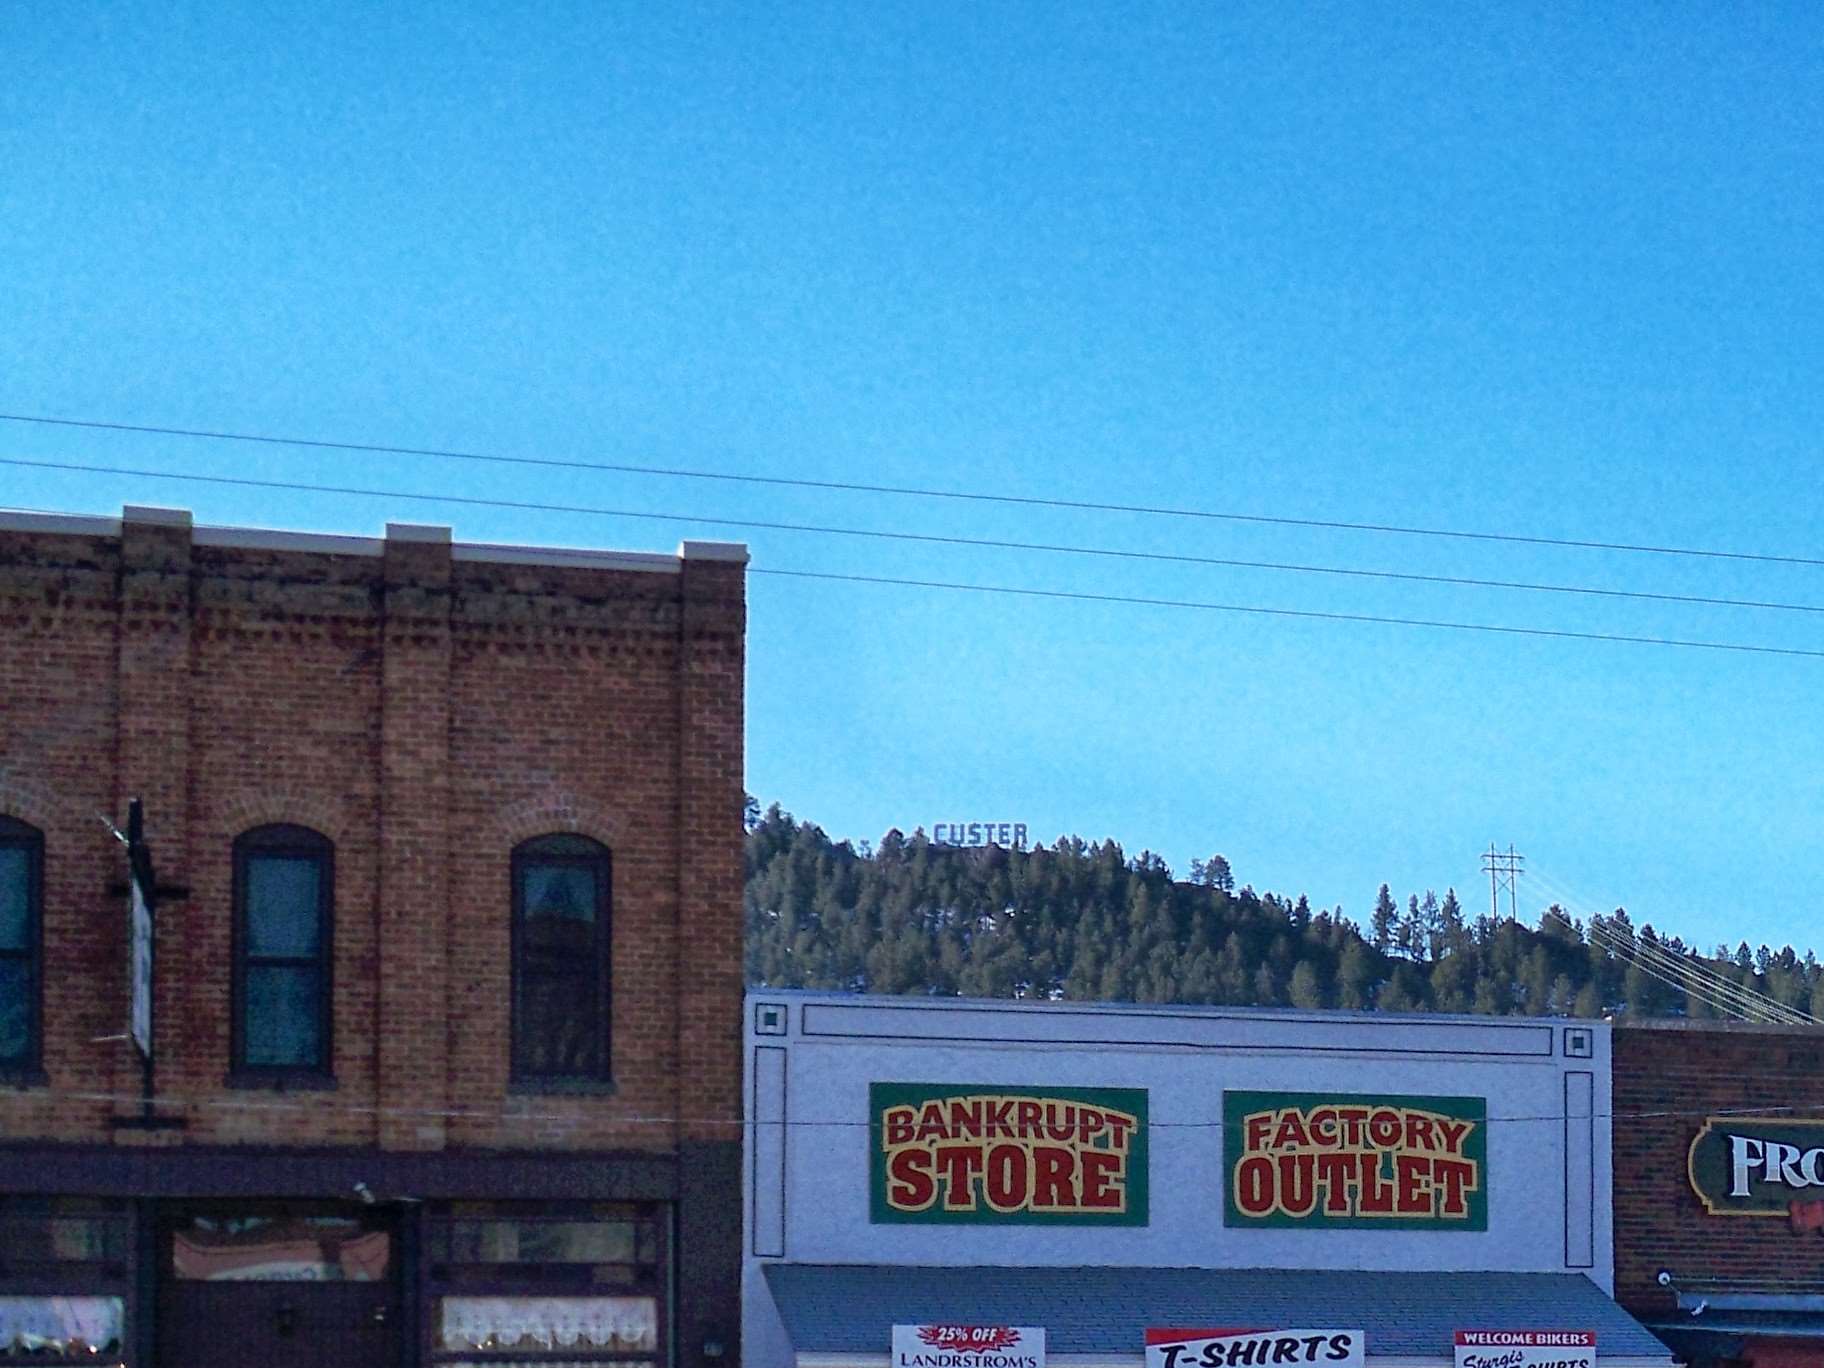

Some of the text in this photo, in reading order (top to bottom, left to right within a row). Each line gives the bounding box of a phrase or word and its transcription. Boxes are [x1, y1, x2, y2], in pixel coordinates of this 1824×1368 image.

[934, 822, 1028, 848] CUSTER
[886, 1098, 1135, 1150] BANKRUPT
[1247, 1108, 1474, 1154] FACTORY
[889, 1143, 1122, 1209] STORE
[1237, 1152, 1475, 1214] OUTLET
[937, 1327, 999, 1343] 25% OFF
[1463, 1332, 1589, 1345] WELCOME BIKERS
